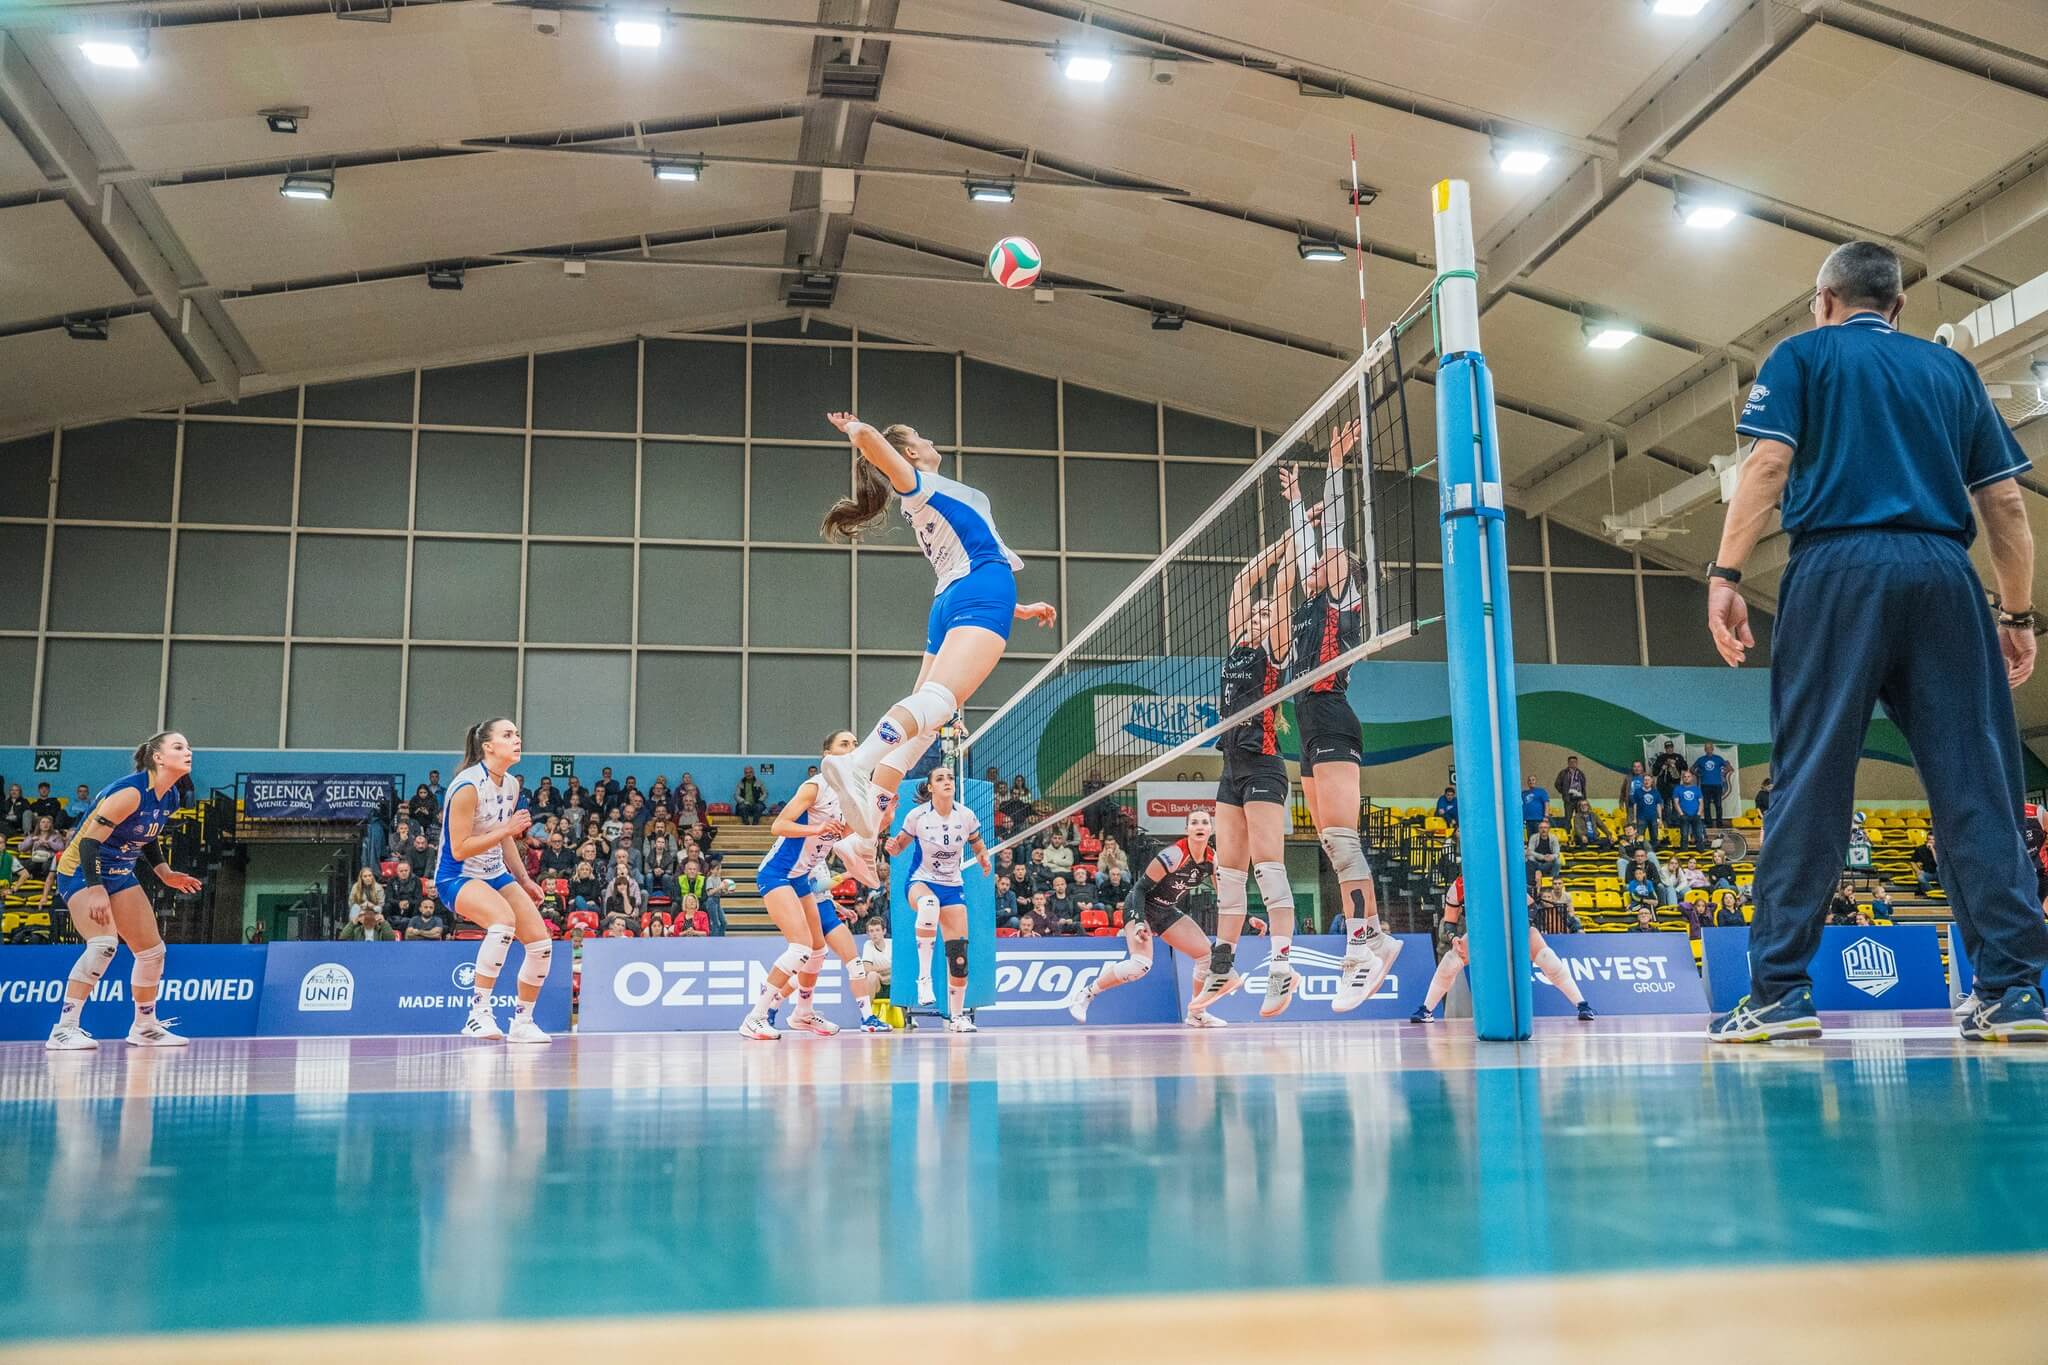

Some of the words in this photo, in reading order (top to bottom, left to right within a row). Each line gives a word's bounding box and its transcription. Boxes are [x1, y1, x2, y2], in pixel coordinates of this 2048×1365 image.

[36, 757, 58, 770] A2
[553, 763, 572, 776] B1
[253, 785, 314, 802] SELENKA
[325, 785, 385, 802] SELENKA
[256, 800, 288, 809] WIENIEC
[328, 800, 360, 809] WIENIEC
[1170, 804, 1191, 813] Bank
[144, 822, 159, 837] 10
[943, 834, 949, 845] 8
[1845, 942, 1894, 977] PRID
[0, 979, 124, 1003] YCHONIA
[131, 978, 254, 1001] UROMED
[305, 986, 348, 1001] UNIA
[1633, 982, 1676, 993] GROUP
[398, 996, 445, 1008] MADE
[447, 996, 463, 1008] IN
